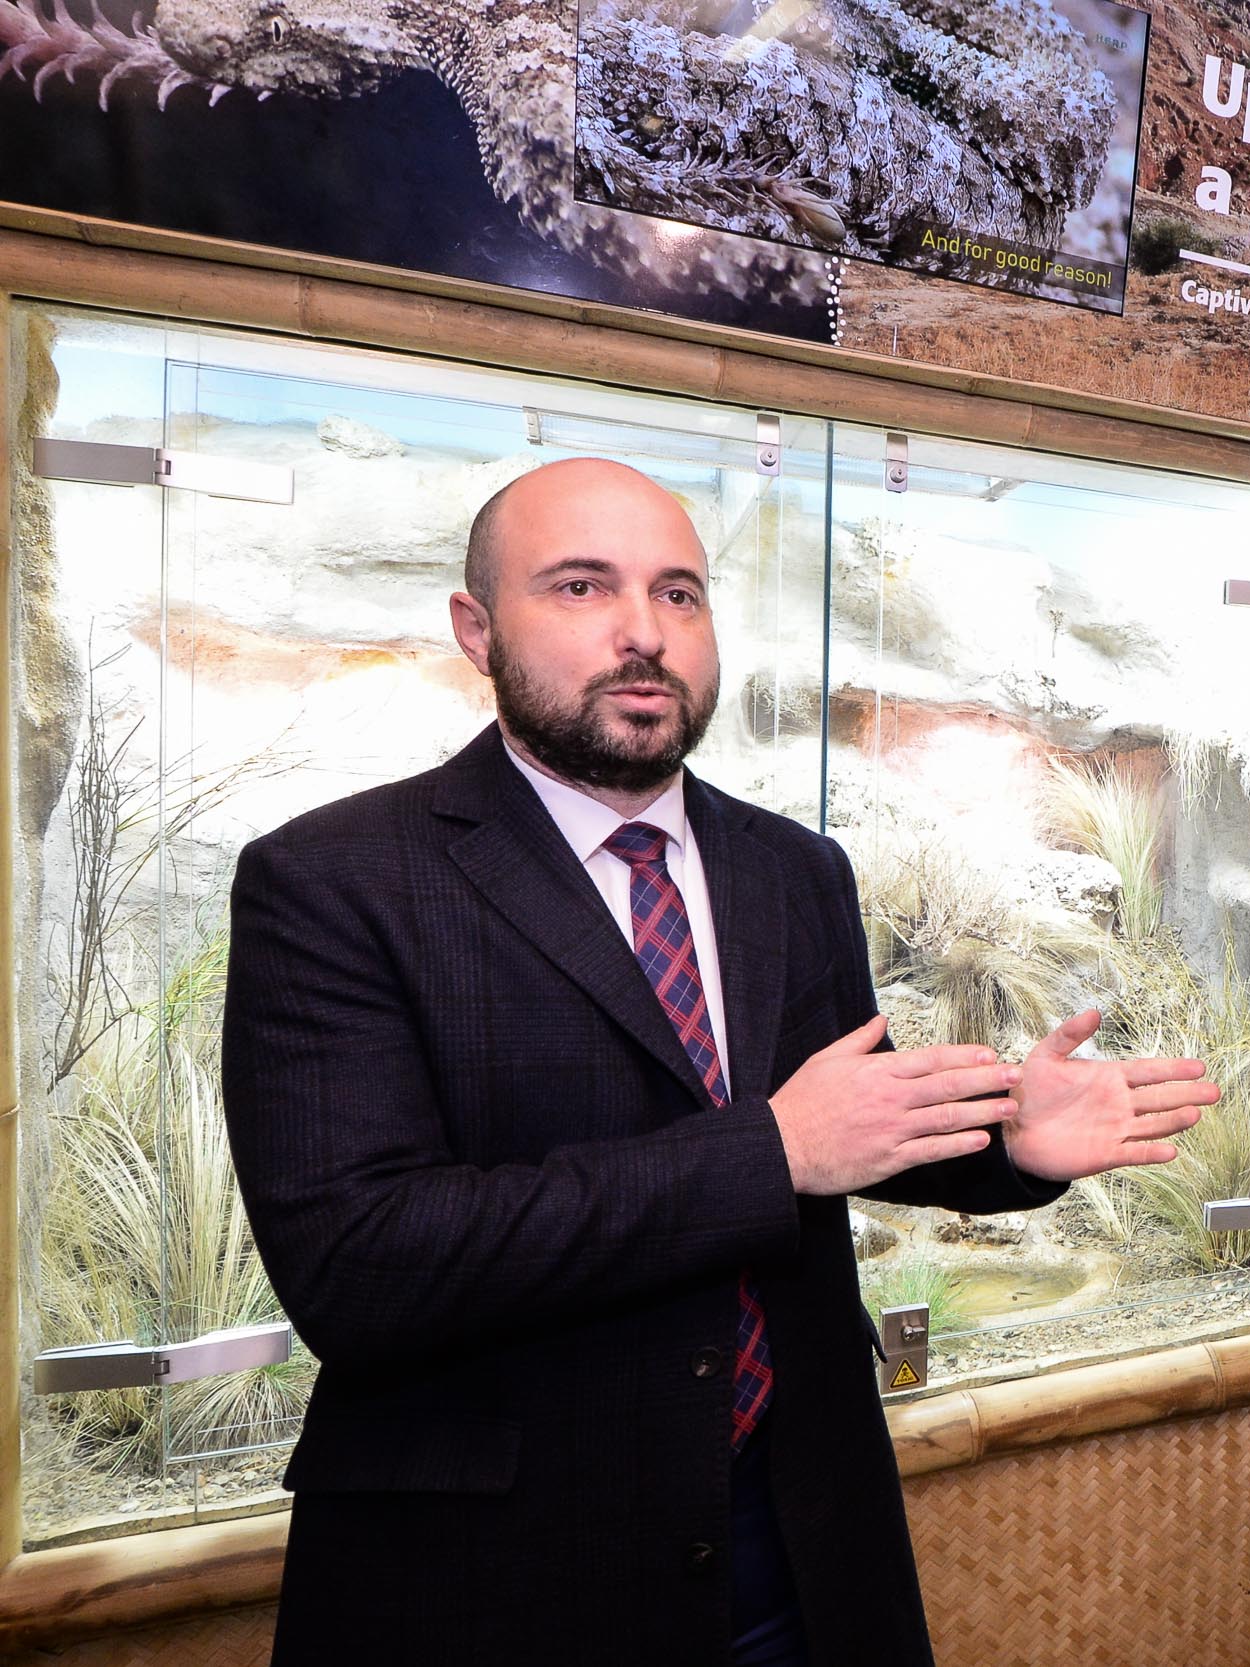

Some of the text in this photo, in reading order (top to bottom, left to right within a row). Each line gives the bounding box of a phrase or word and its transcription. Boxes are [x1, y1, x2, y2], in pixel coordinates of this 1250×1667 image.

[1195, 165, 1231, 216] a
[921, 229, 1112, 289] And for good reason!
